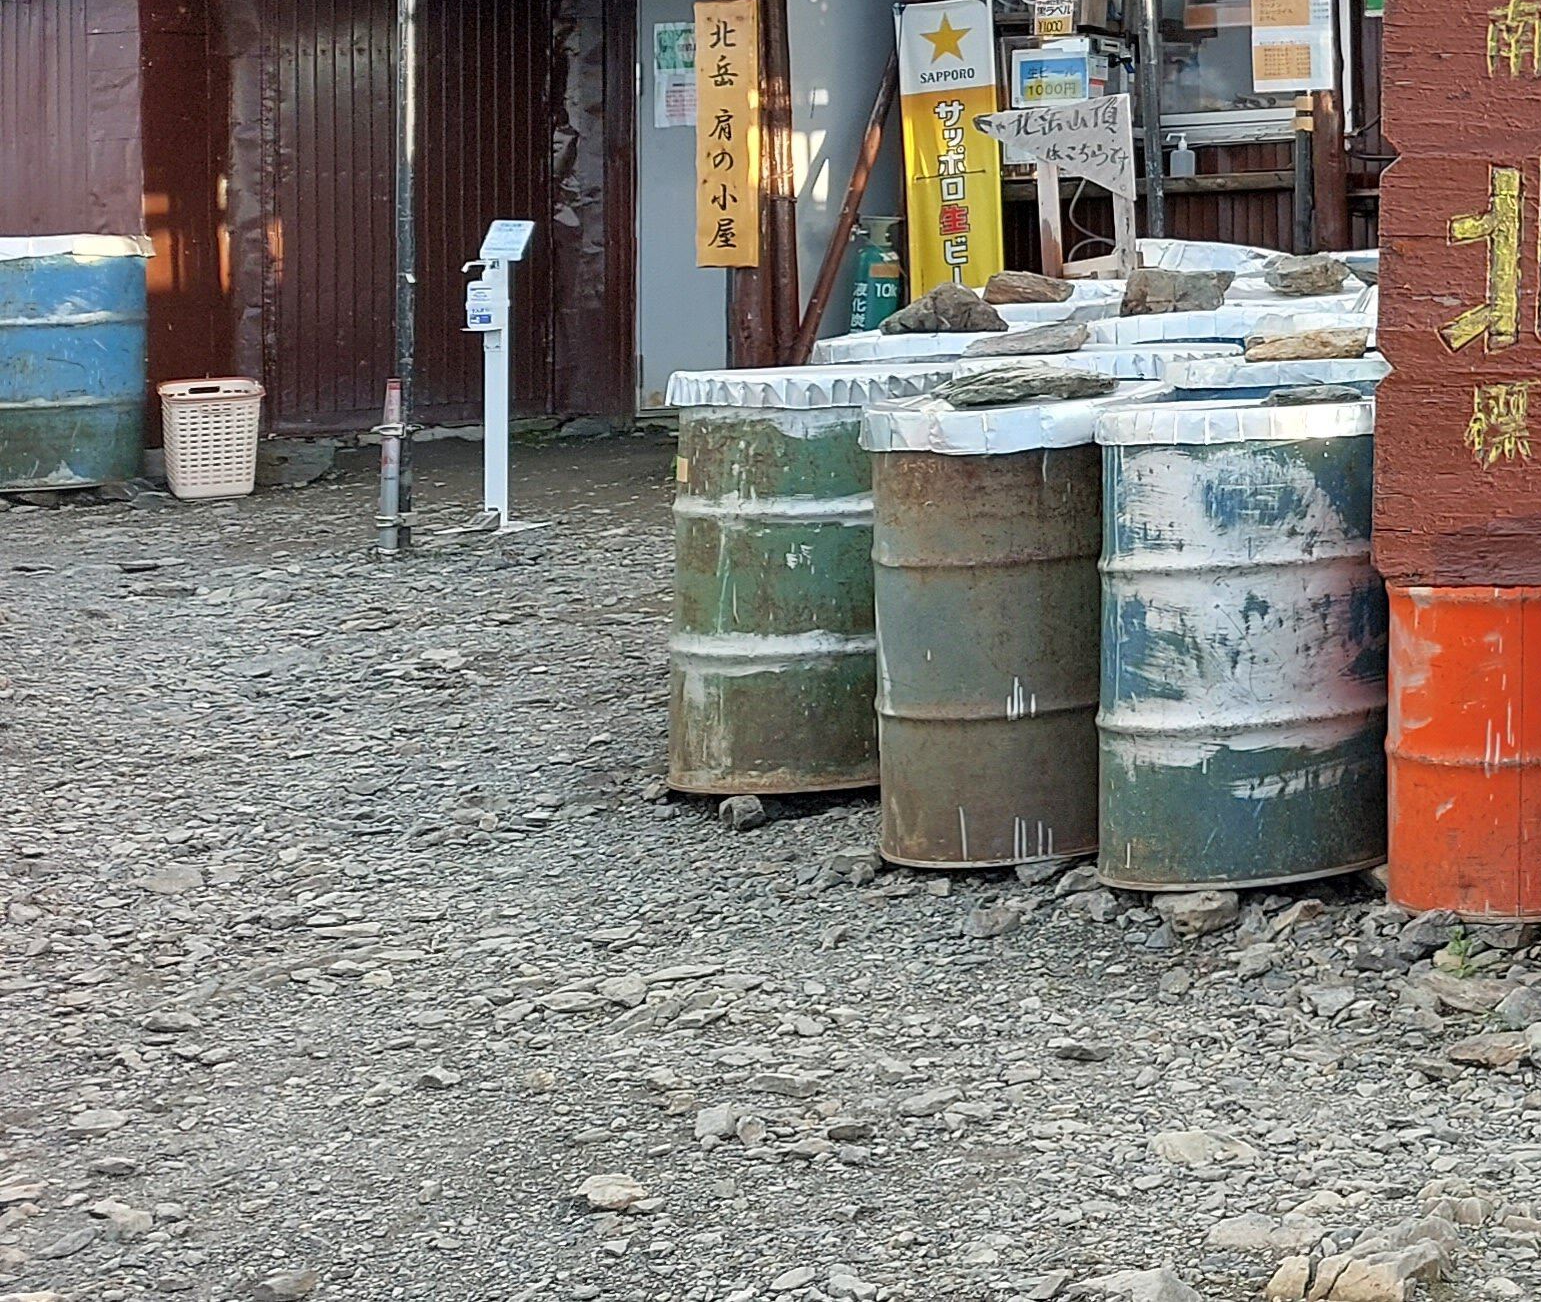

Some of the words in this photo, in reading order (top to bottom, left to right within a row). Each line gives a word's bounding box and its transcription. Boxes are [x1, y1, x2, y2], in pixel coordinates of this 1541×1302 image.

[919, 66, 976, 84] SAPPORO
[1028, 82, 1076, 96] 1000円
[850, 282, 868, 333] 液化炭
